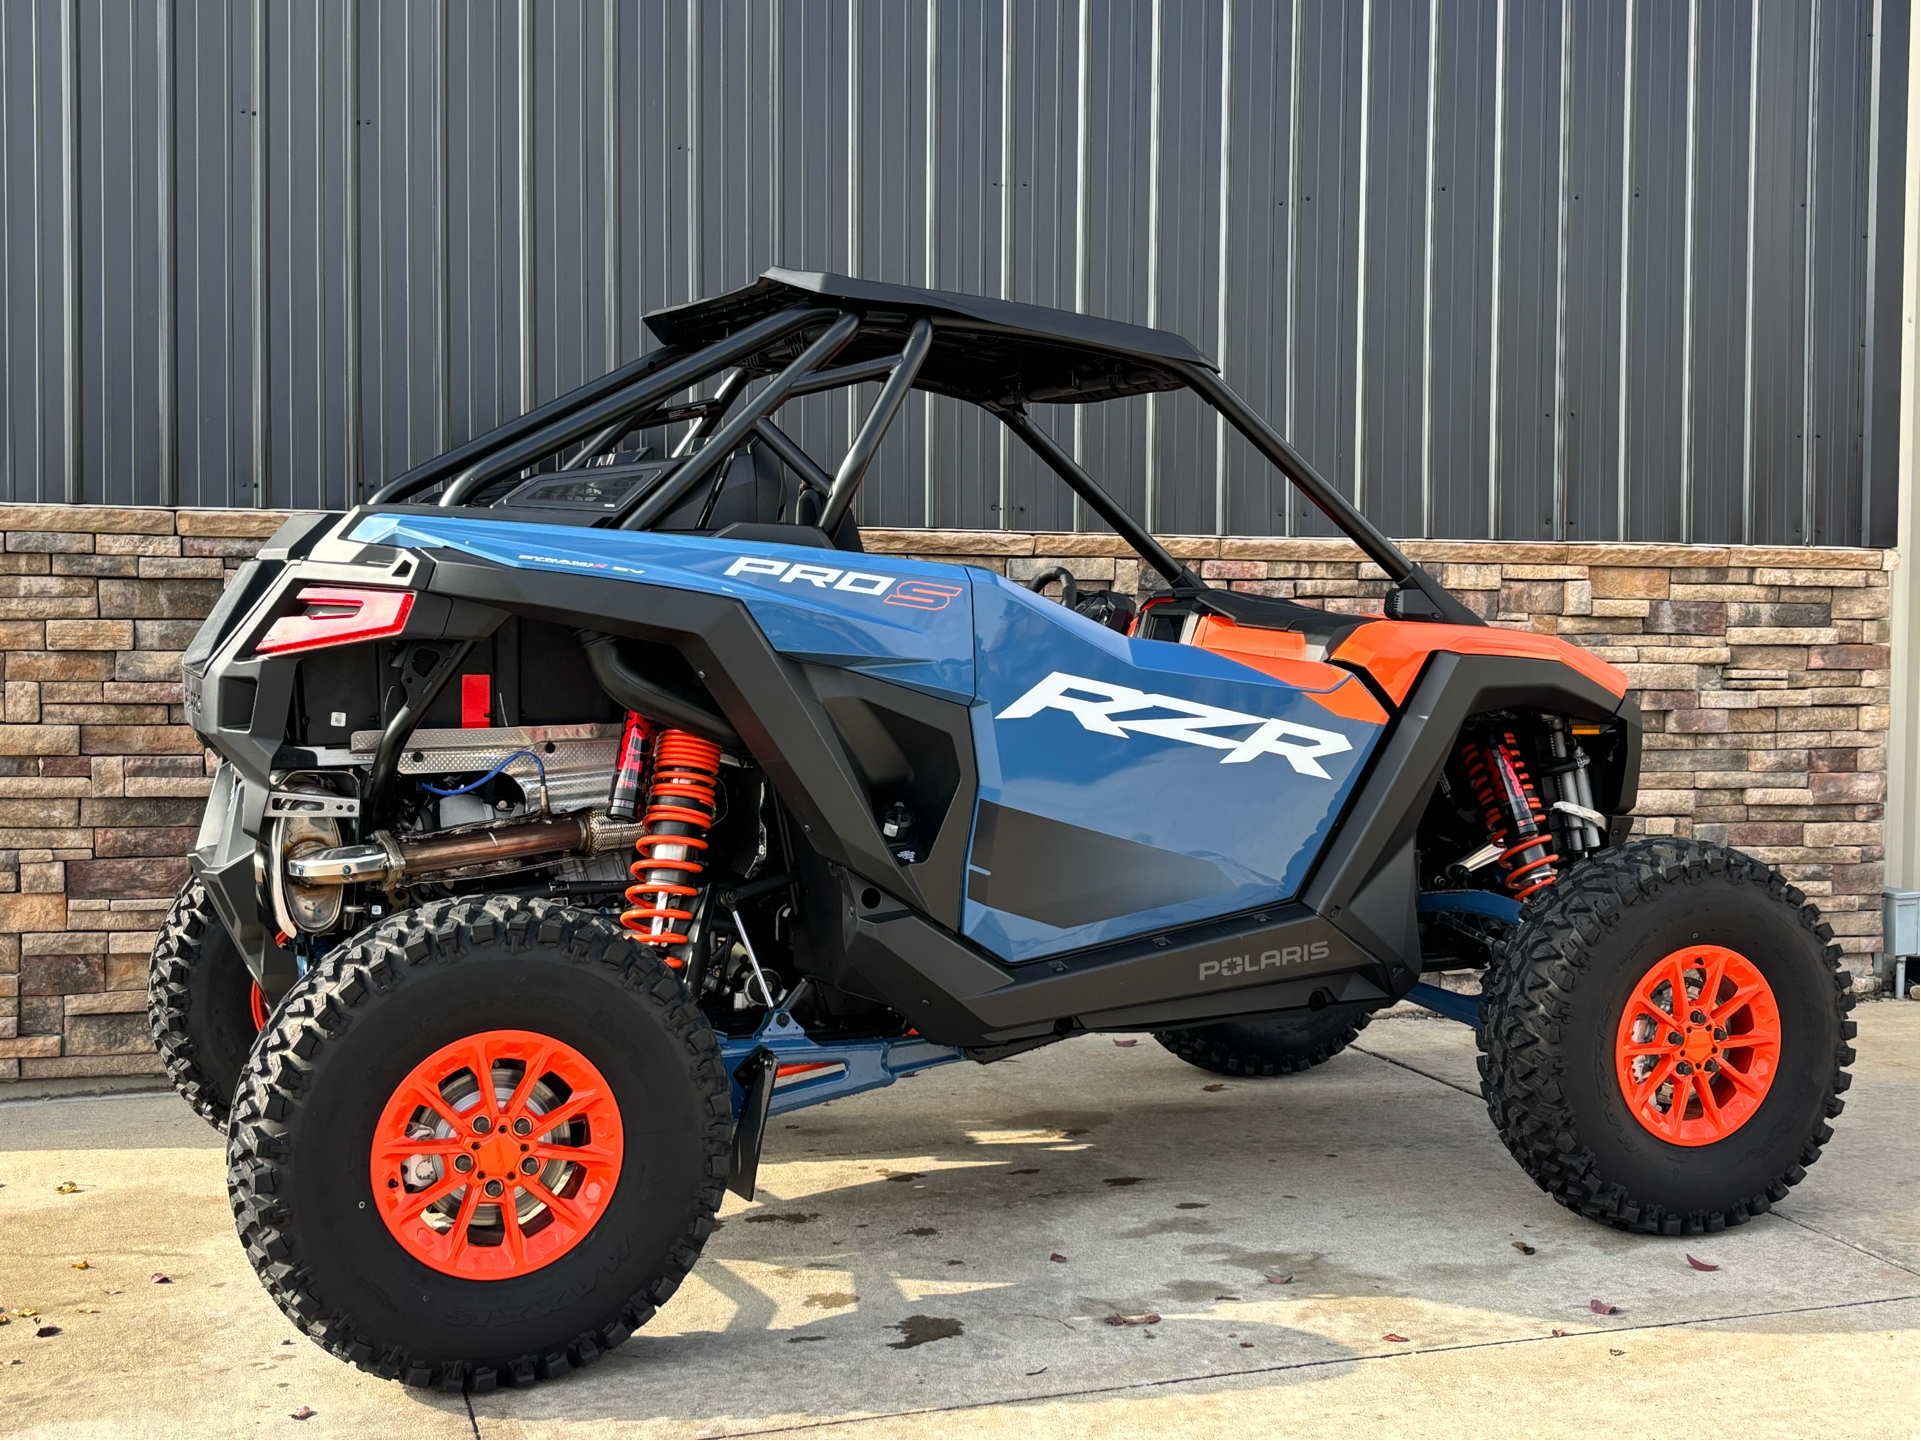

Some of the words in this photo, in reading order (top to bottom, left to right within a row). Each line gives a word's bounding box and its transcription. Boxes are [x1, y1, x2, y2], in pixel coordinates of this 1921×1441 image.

[724, 557, 895, 596] PRO
[883, 581, 963, 610] S
[995, 671, 1353, 780] RZR
[1199, 940, 1330, 981] POLARIS
